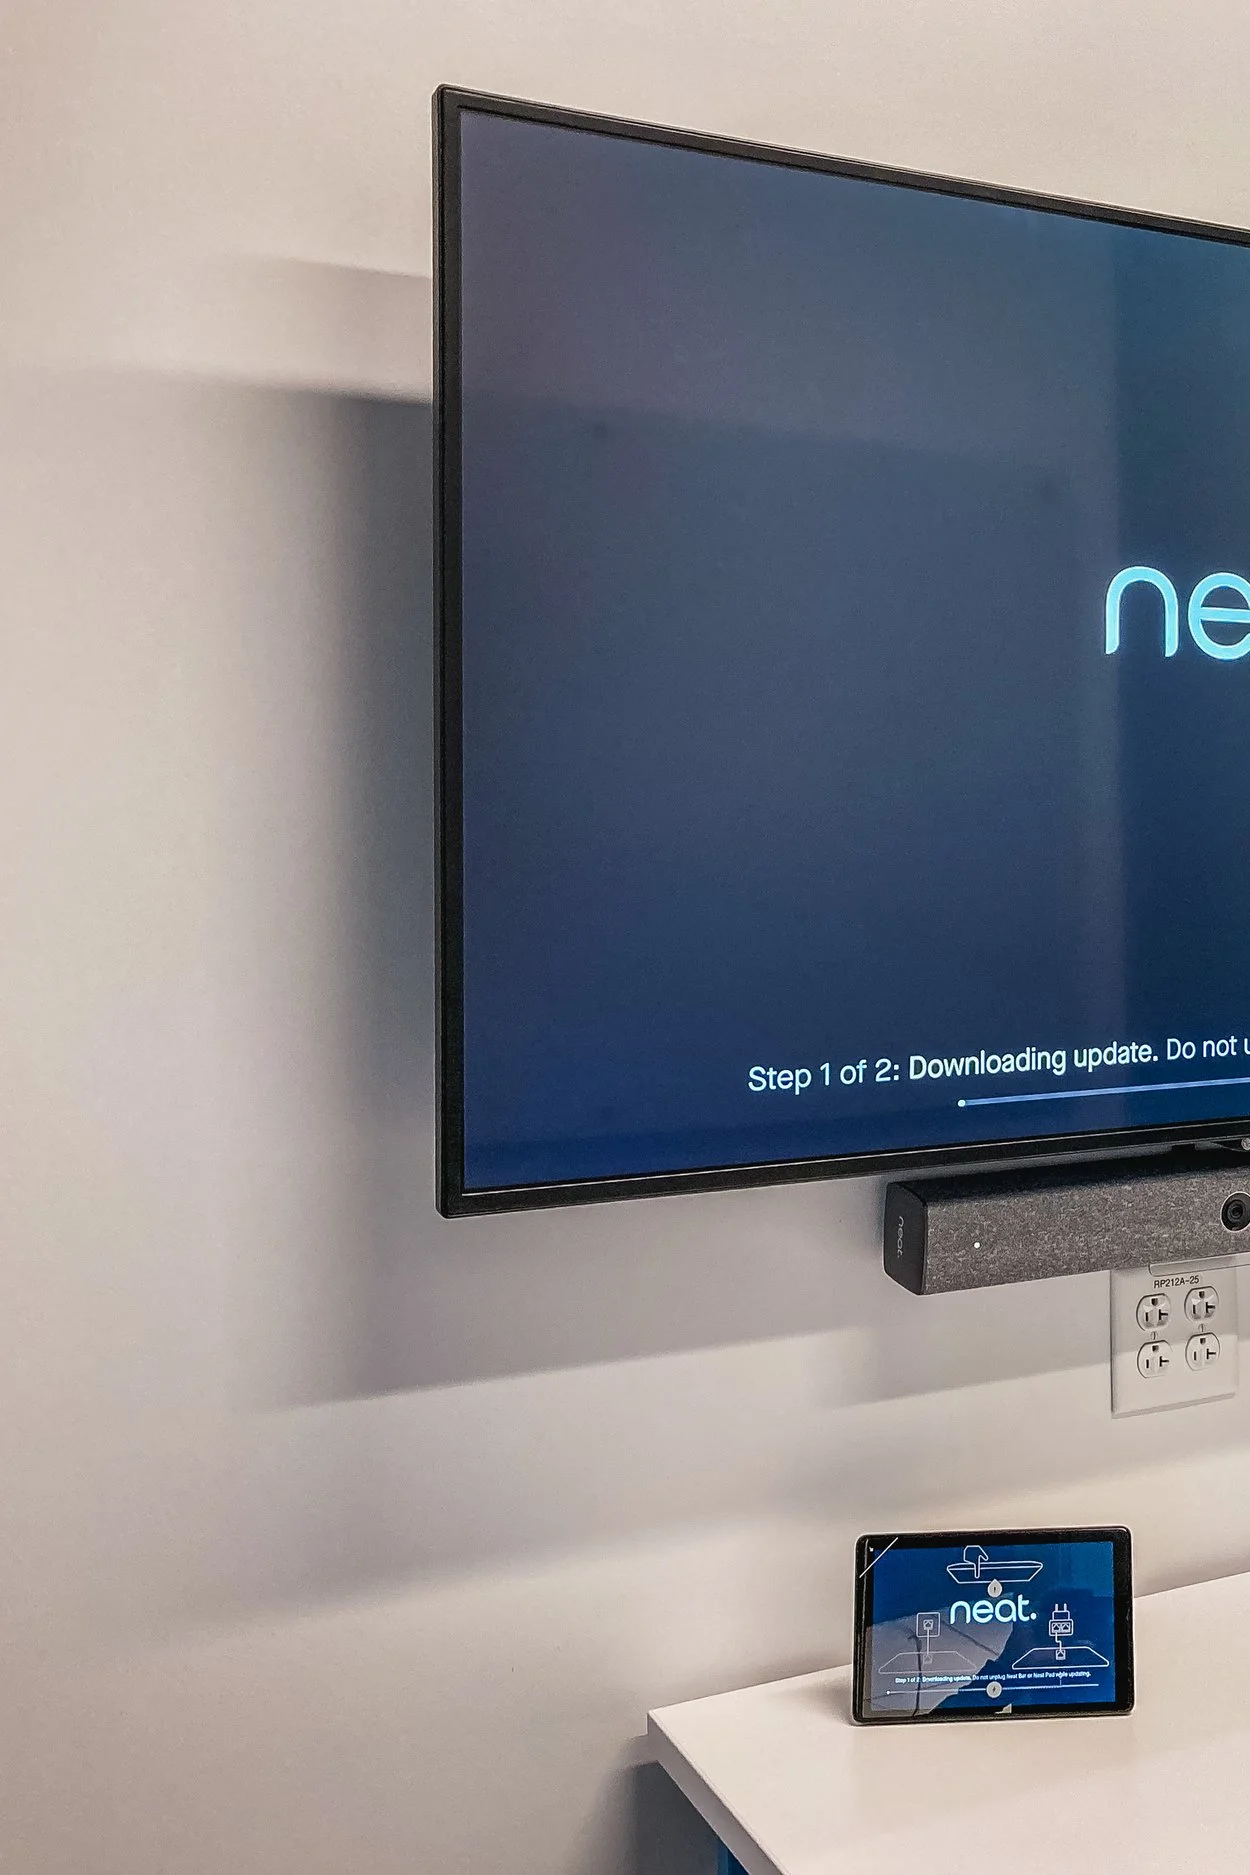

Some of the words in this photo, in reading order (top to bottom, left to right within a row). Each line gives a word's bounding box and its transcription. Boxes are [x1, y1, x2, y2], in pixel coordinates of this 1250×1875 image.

[748, 1066, 812, 1095] Step
[820, 1062, 830, 1086] 1
[840, 1059, 868, 1085] of
[875, 1058, 900, 1082] 2:
[909, 1047, 1066, 1080] Downloading
[1073, 1041, 1159, 1072] update.
[1166, 1038, 1196, 1060] Do
[1202, 1035, 1238, 1058] not
[1153, 1275, 1200, 1289] RP212A-25
[950, 1594, 1037, 1625] neat.
